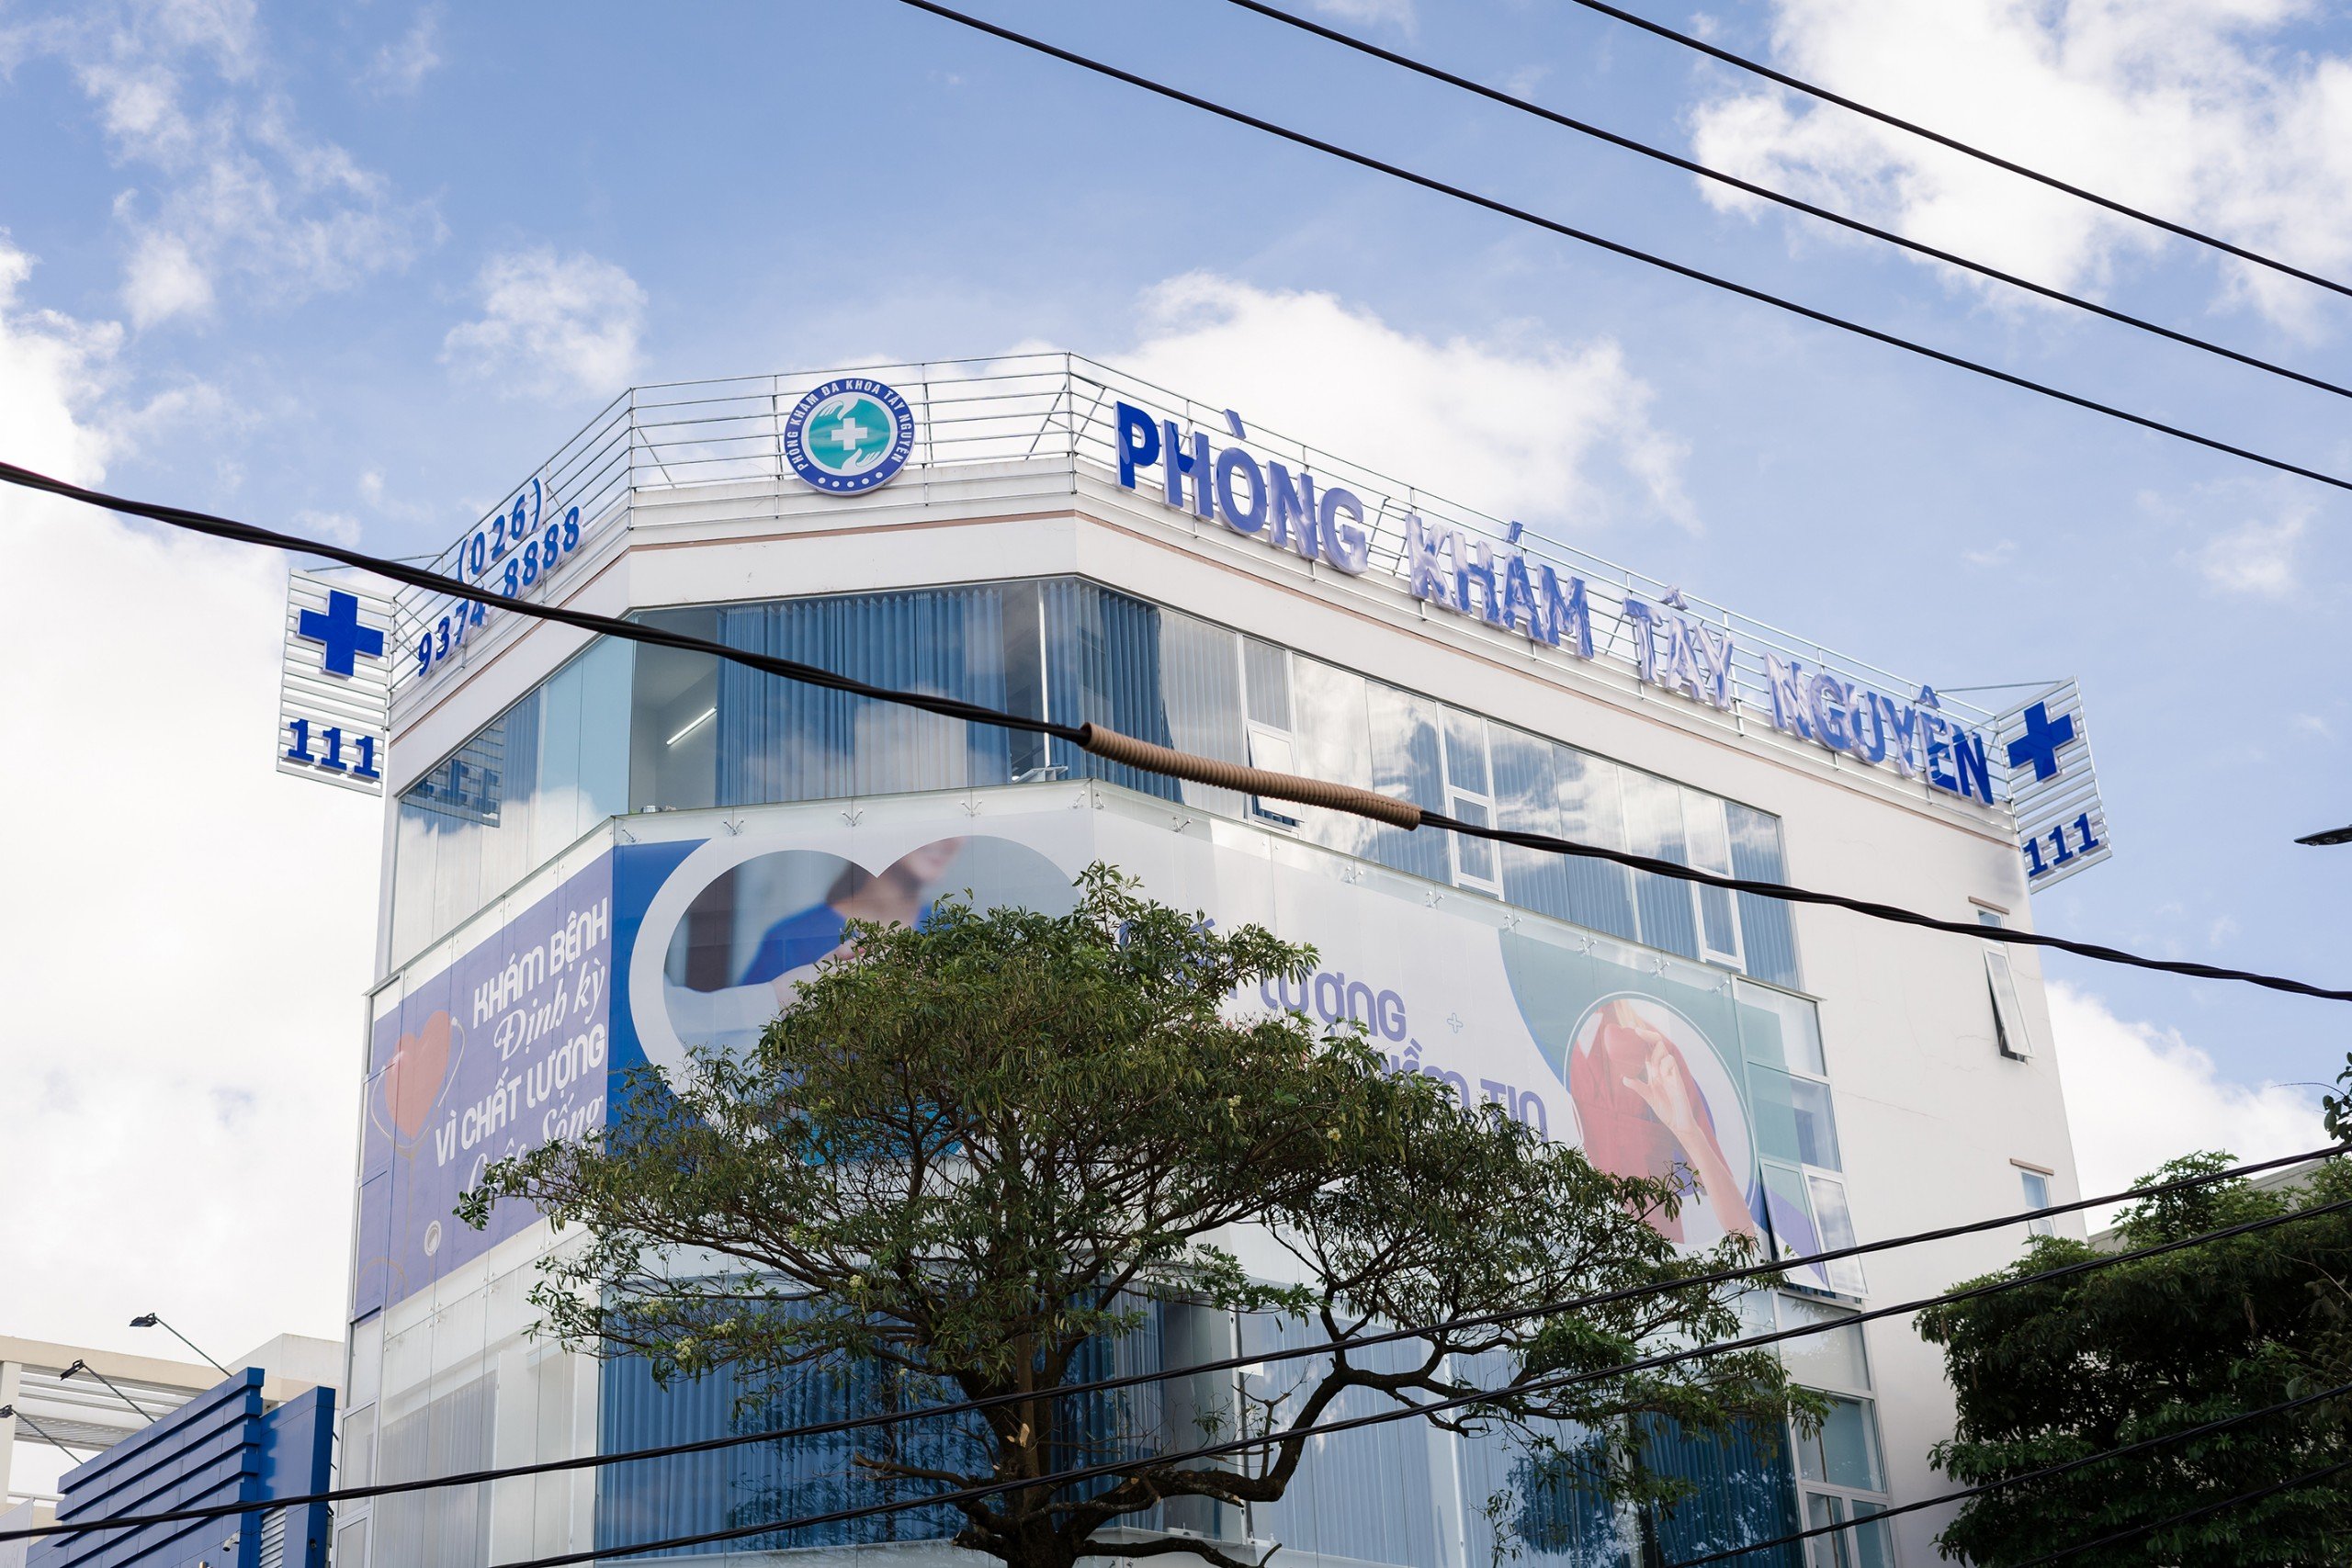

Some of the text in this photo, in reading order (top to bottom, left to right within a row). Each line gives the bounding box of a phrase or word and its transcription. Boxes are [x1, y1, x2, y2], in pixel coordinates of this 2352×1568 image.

[786, 379, 913, 471] PHÒNG KHÁM ĐA KHOA TÂY NGUYÊN
[458, 477, 544, 583] (026)
[503, 506, 582, 598] 8888
[1114, 400, 1995, 807] PHÒNG KHÁM TÂY NGUYÊN
[287, 718, 380, 779] 111
[2023, 812, 2100, 879] 111
[473, 897, 608, 1030] KHÁM BỆNH
[493, 957, 605, 1062] Định kỳ
[435, 1110, 457, 1168] VÌ
[461, 1066, 522, 1150] CHẤT
